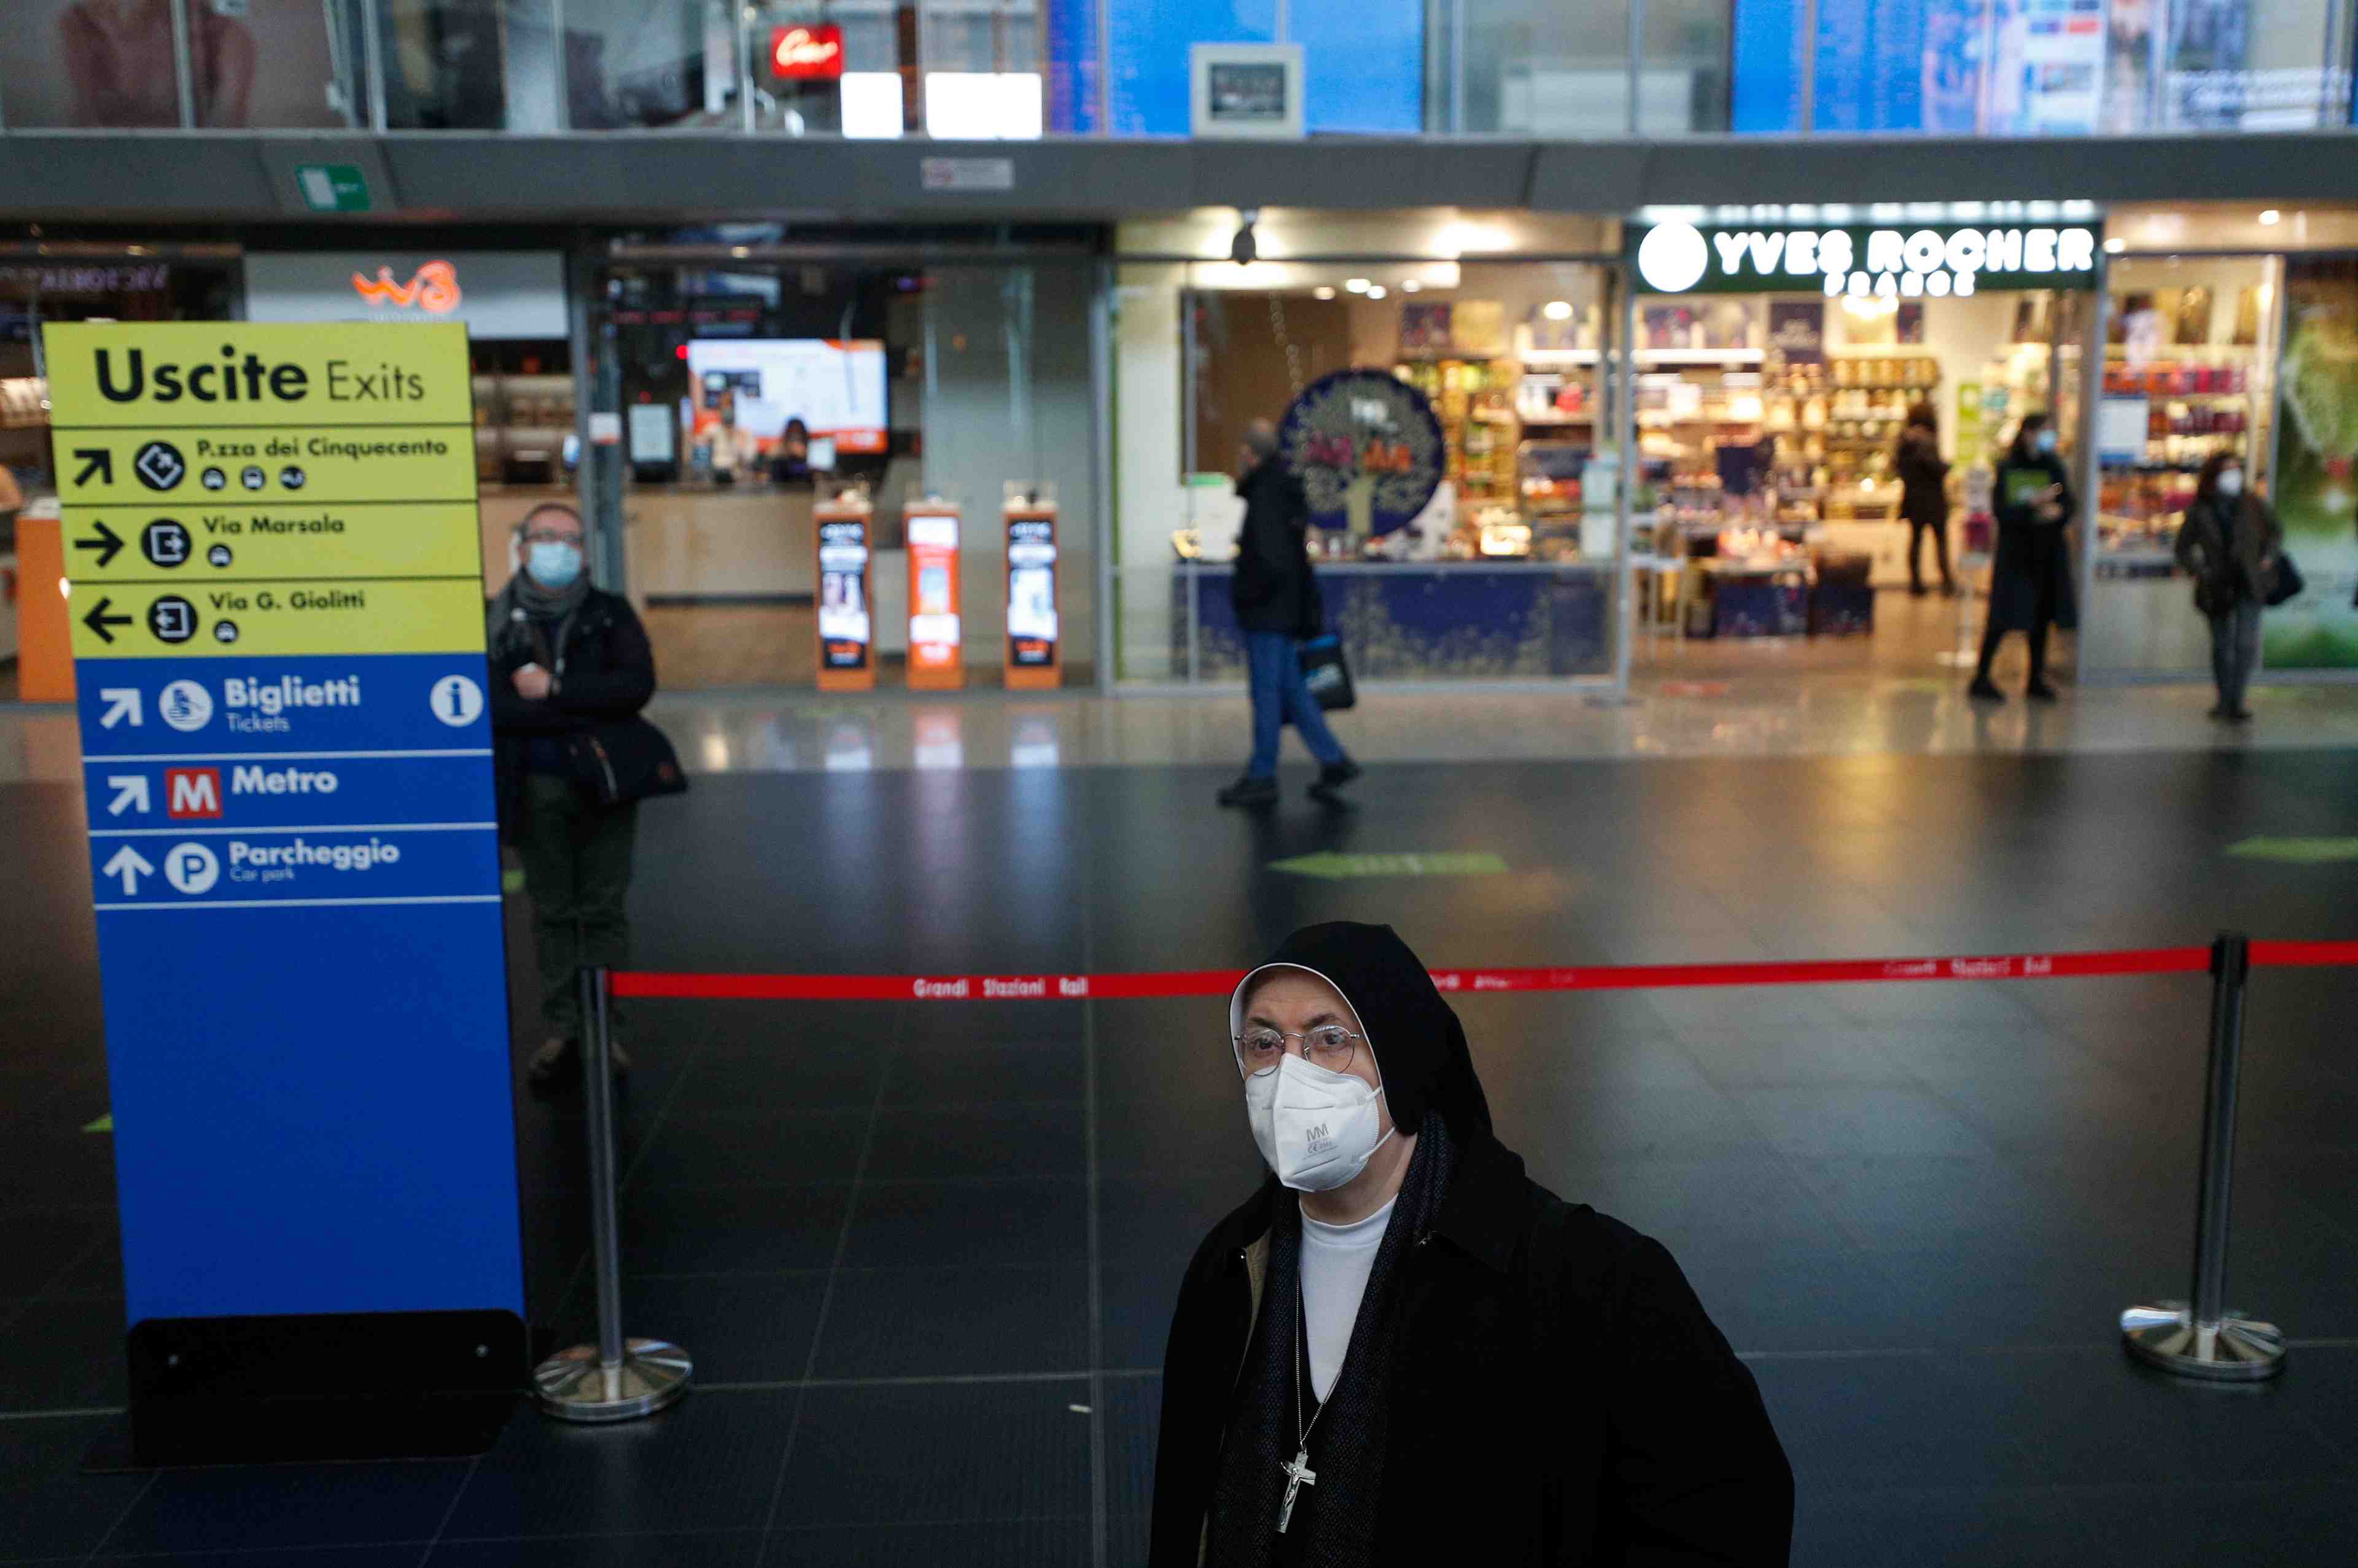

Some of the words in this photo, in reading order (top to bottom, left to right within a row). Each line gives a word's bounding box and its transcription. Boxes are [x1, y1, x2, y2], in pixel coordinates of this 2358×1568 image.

[1713, 228, 1854, 276] YVES
[1867, 227, 2095, 275] ROCHER
[94, 344, 309, 403] Uscite
[327, 360, 425, 401] Exits
[196, 439, 255, 457] P.zza
[265, 438, 299, 456] dei
[308, 438, 448, 460] Cinquecento
[203, 516, 241, 534] Via
[251, 514, 345, 534] Marsala
[209, 592, 248, 610] Via
[256, 591, 282, 610] G.
[290, 589, 365, 610] Giolitti
[224, 675, 360, 715] Biglietti
[226, 712, 290, 732] Tickets
[173, 774, 217, 812] M
[232, 765, 338, 794] Metro
[228, 837, 400, 871] Parcheggio
[229, 866, 258, 882] Car
[262, 864, 295, 884] park
[913, 978, 969, 997] Grandi
[983, 977, 1045, 996] Stazioni
[1059, 977, 1088, 995] Rail
